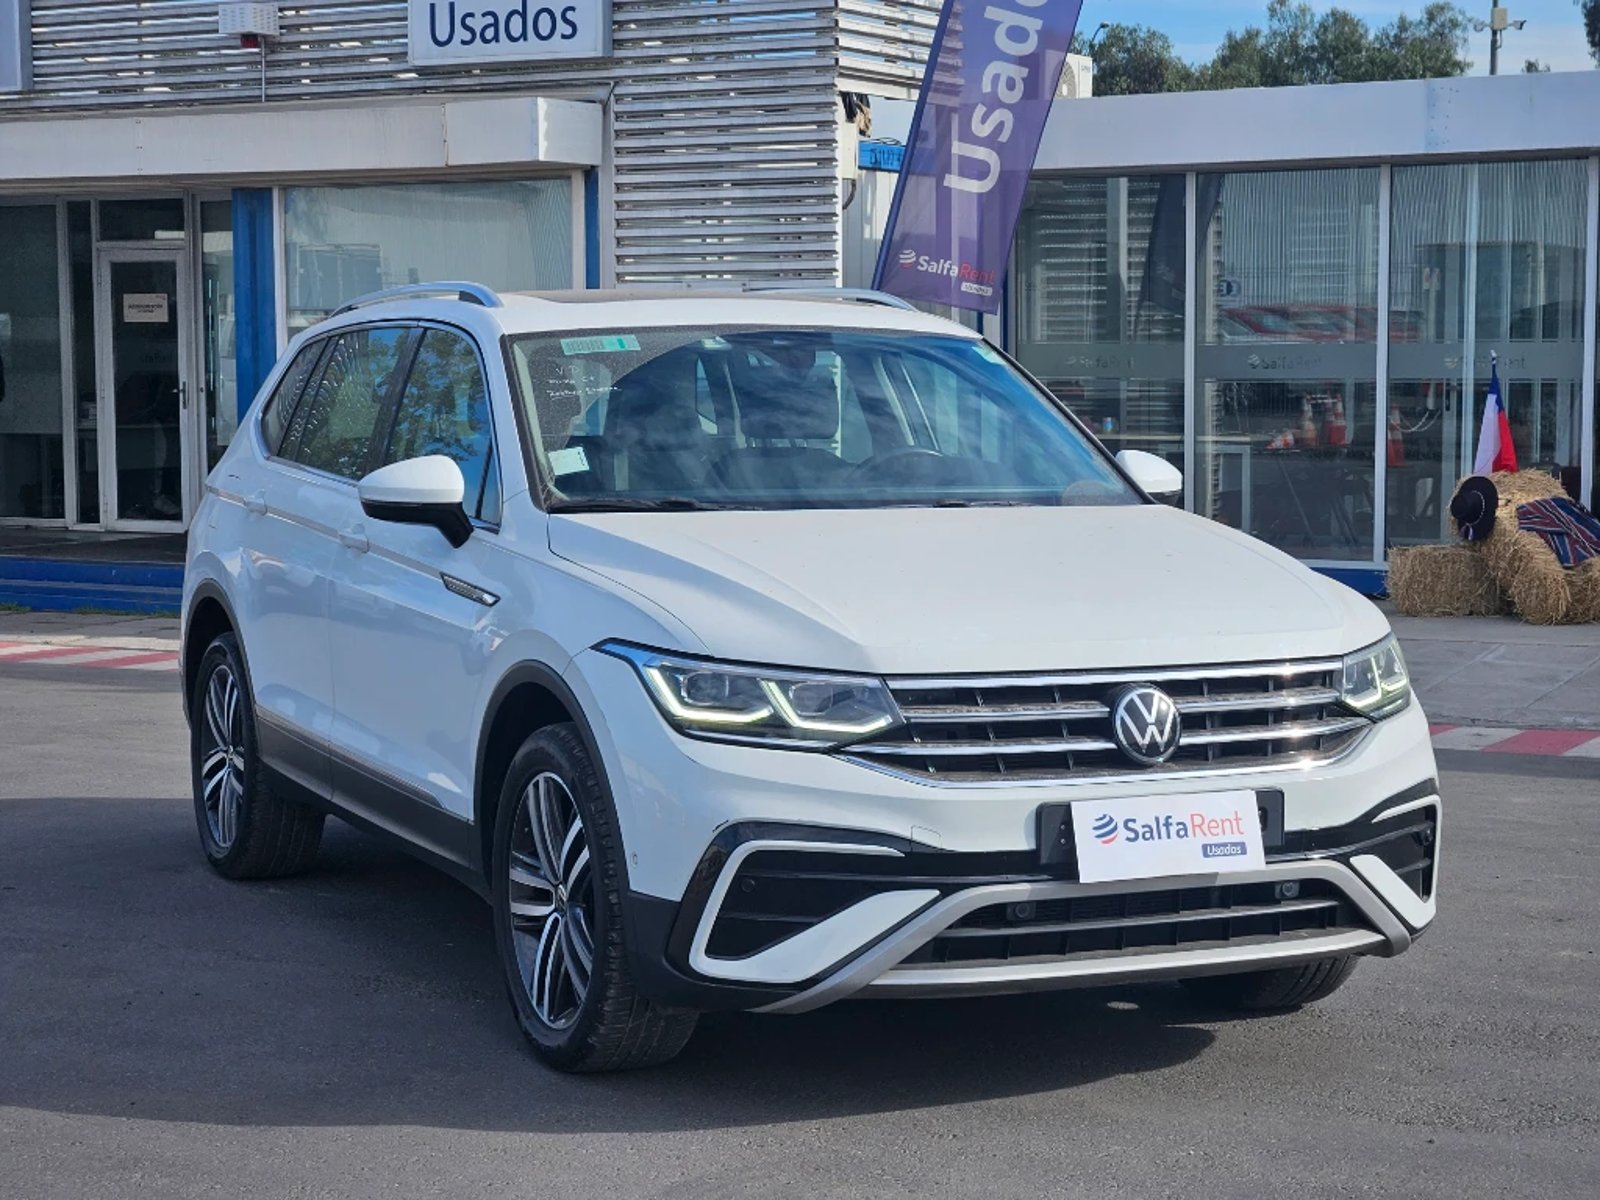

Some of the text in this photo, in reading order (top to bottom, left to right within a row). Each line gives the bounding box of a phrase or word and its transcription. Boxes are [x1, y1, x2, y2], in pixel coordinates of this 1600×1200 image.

[429, 0, 578, 47] Usados
[943, 0, 1050, 193] Usad
[917, 255, 997, 285] SalfaRent
[1123, 810, 1245, 843] SalfaRent
[1207, 845, 1241, 856] Usados
